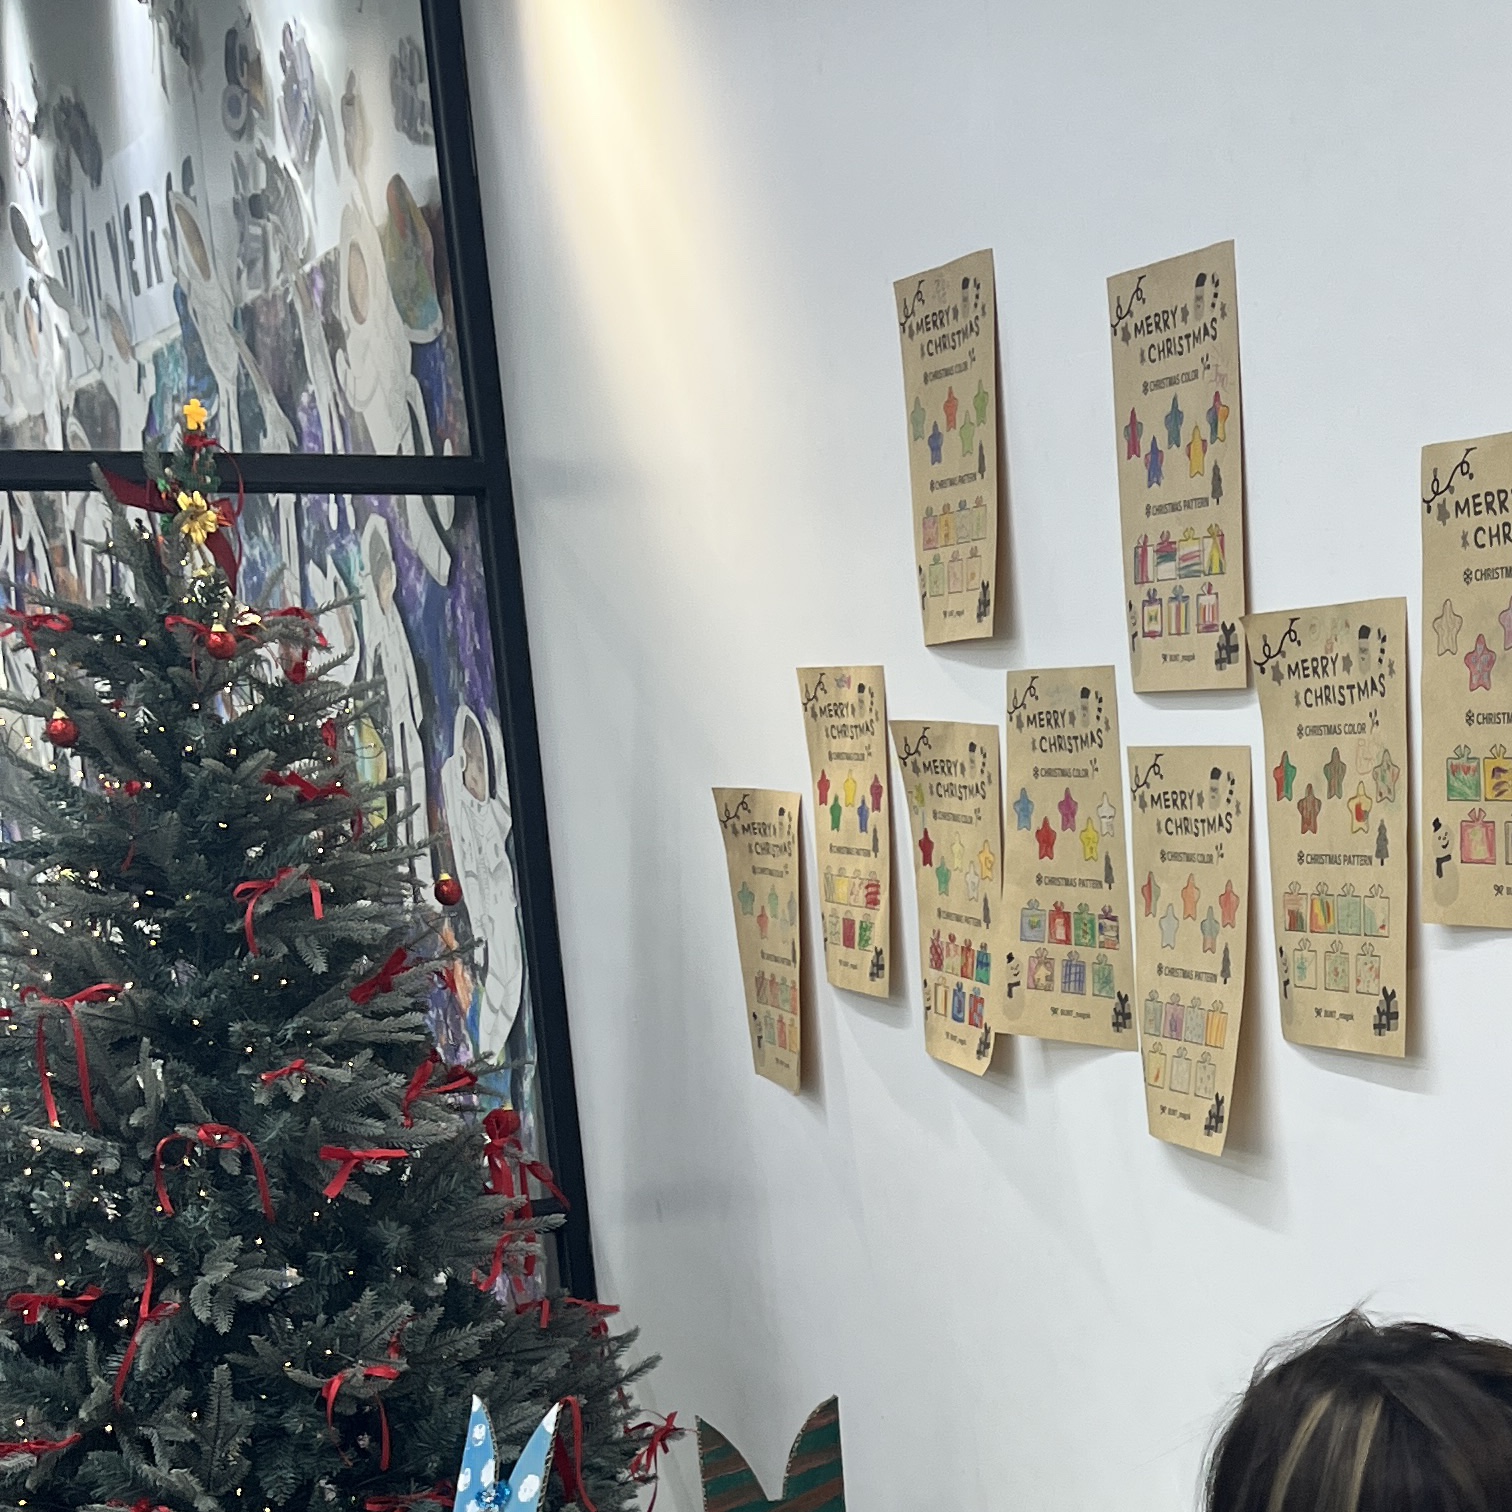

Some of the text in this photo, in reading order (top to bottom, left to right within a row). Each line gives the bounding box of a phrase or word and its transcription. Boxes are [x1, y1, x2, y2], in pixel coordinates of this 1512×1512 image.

[915, 305, 951, 335] MERRY
[1134, 304, 1178, 339] MERRY
[926, 315, 980, 357] CHRISTMAS
[1148, 317, 1218, 364] CHRISTMAS
[1287, 653, 1339, 681] MERRY
[1304, 673, 1386, 708] CHRISTMAS
[819, 701, 850, 718] MERRY
[1026, 708, 1066, 729] MERRY
[830, 718, 874, 740] CHRISTMAS
[1305, 723, 1366, 737] CHRISTMAS COLOR
[1039, 728, 1103, 754] CHRISTMAS
[922, 759, 958, 777] MERRY
[936, 781, 986, 801] CHRISTMAS
[1150, 789, 1195, 811] MERRY
[742, 821, 772, 838] MERRY
[1164, 811, 1233, 838] CHRISTMAS
[1306, 854, 1373, 867] CHRISTMAS PATTERN
